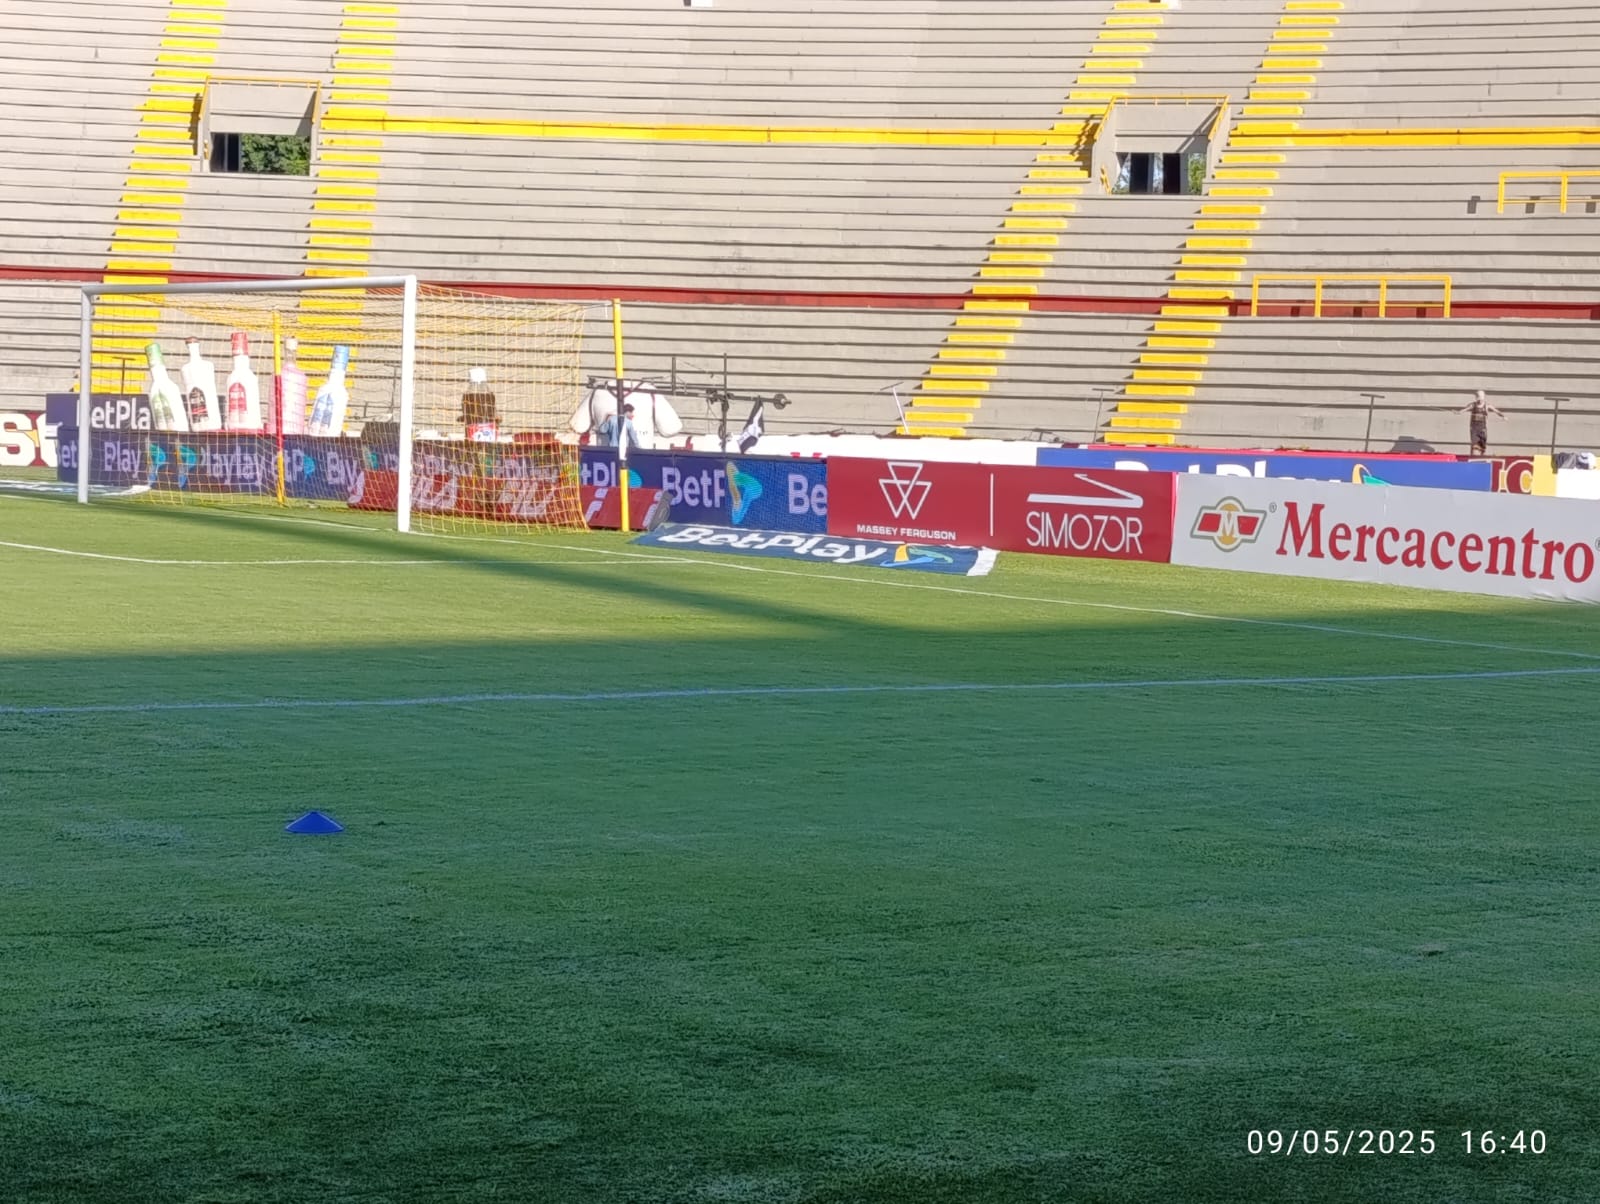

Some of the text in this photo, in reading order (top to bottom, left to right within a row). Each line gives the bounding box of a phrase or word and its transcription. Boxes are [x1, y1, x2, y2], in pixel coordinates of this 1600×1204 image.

[76, 397, 151, 430] etPla
[657, 526, 888, 563] BetPlay
[856, 524, 957, 541] MASSEY FERGUSON
[1275, 501, 1594, 584] Mercacentro
